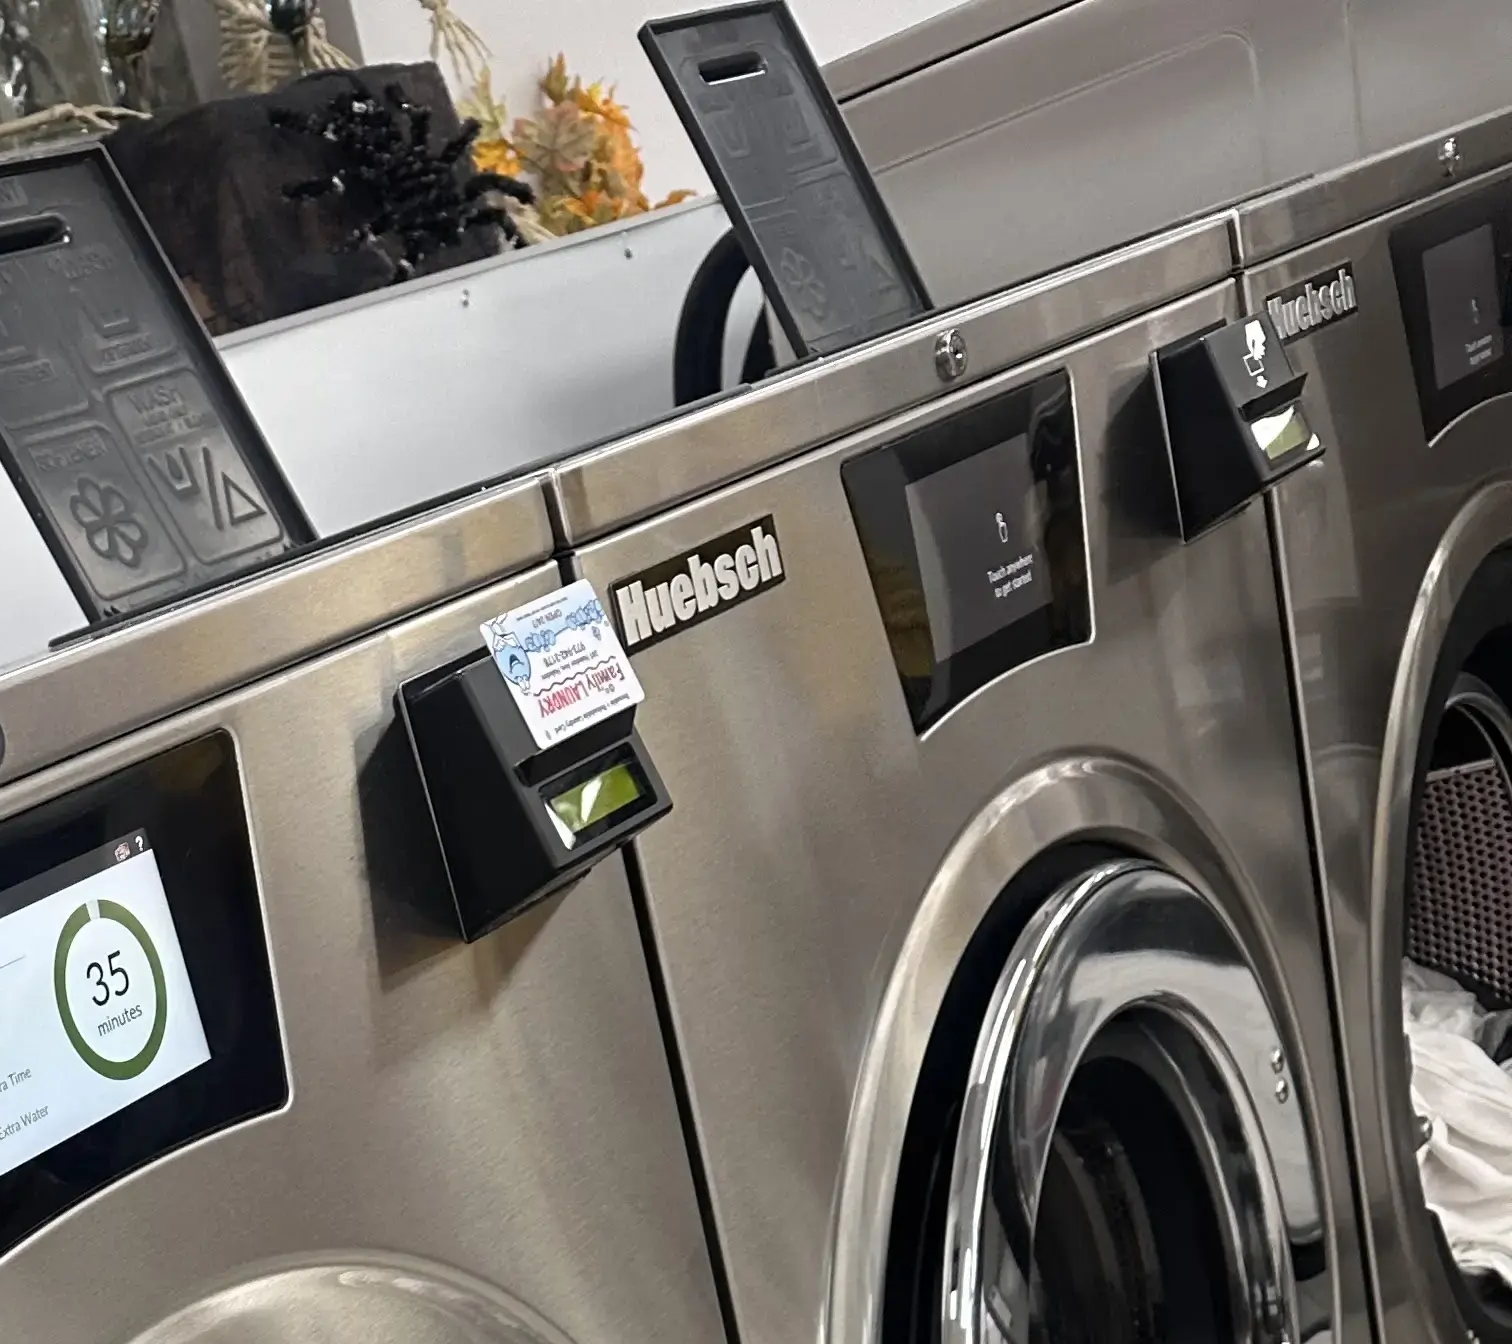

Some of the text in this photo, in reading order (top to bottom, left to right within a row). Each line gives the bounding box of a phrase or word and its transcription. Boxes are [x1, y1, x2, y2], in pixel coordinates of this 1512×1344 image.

[1266, 268, 1357, 340] Huebsch
[616, 526, 782, 646] Huebsch
[538, 661, 626, 718] Family LAUNDRY
[85, 949, 130, 1007] 35
[96, 1002, 144, 1037] minutes
[7, 1064, 32, 1087] Time
[20, 1102, 50, 1128] Water
